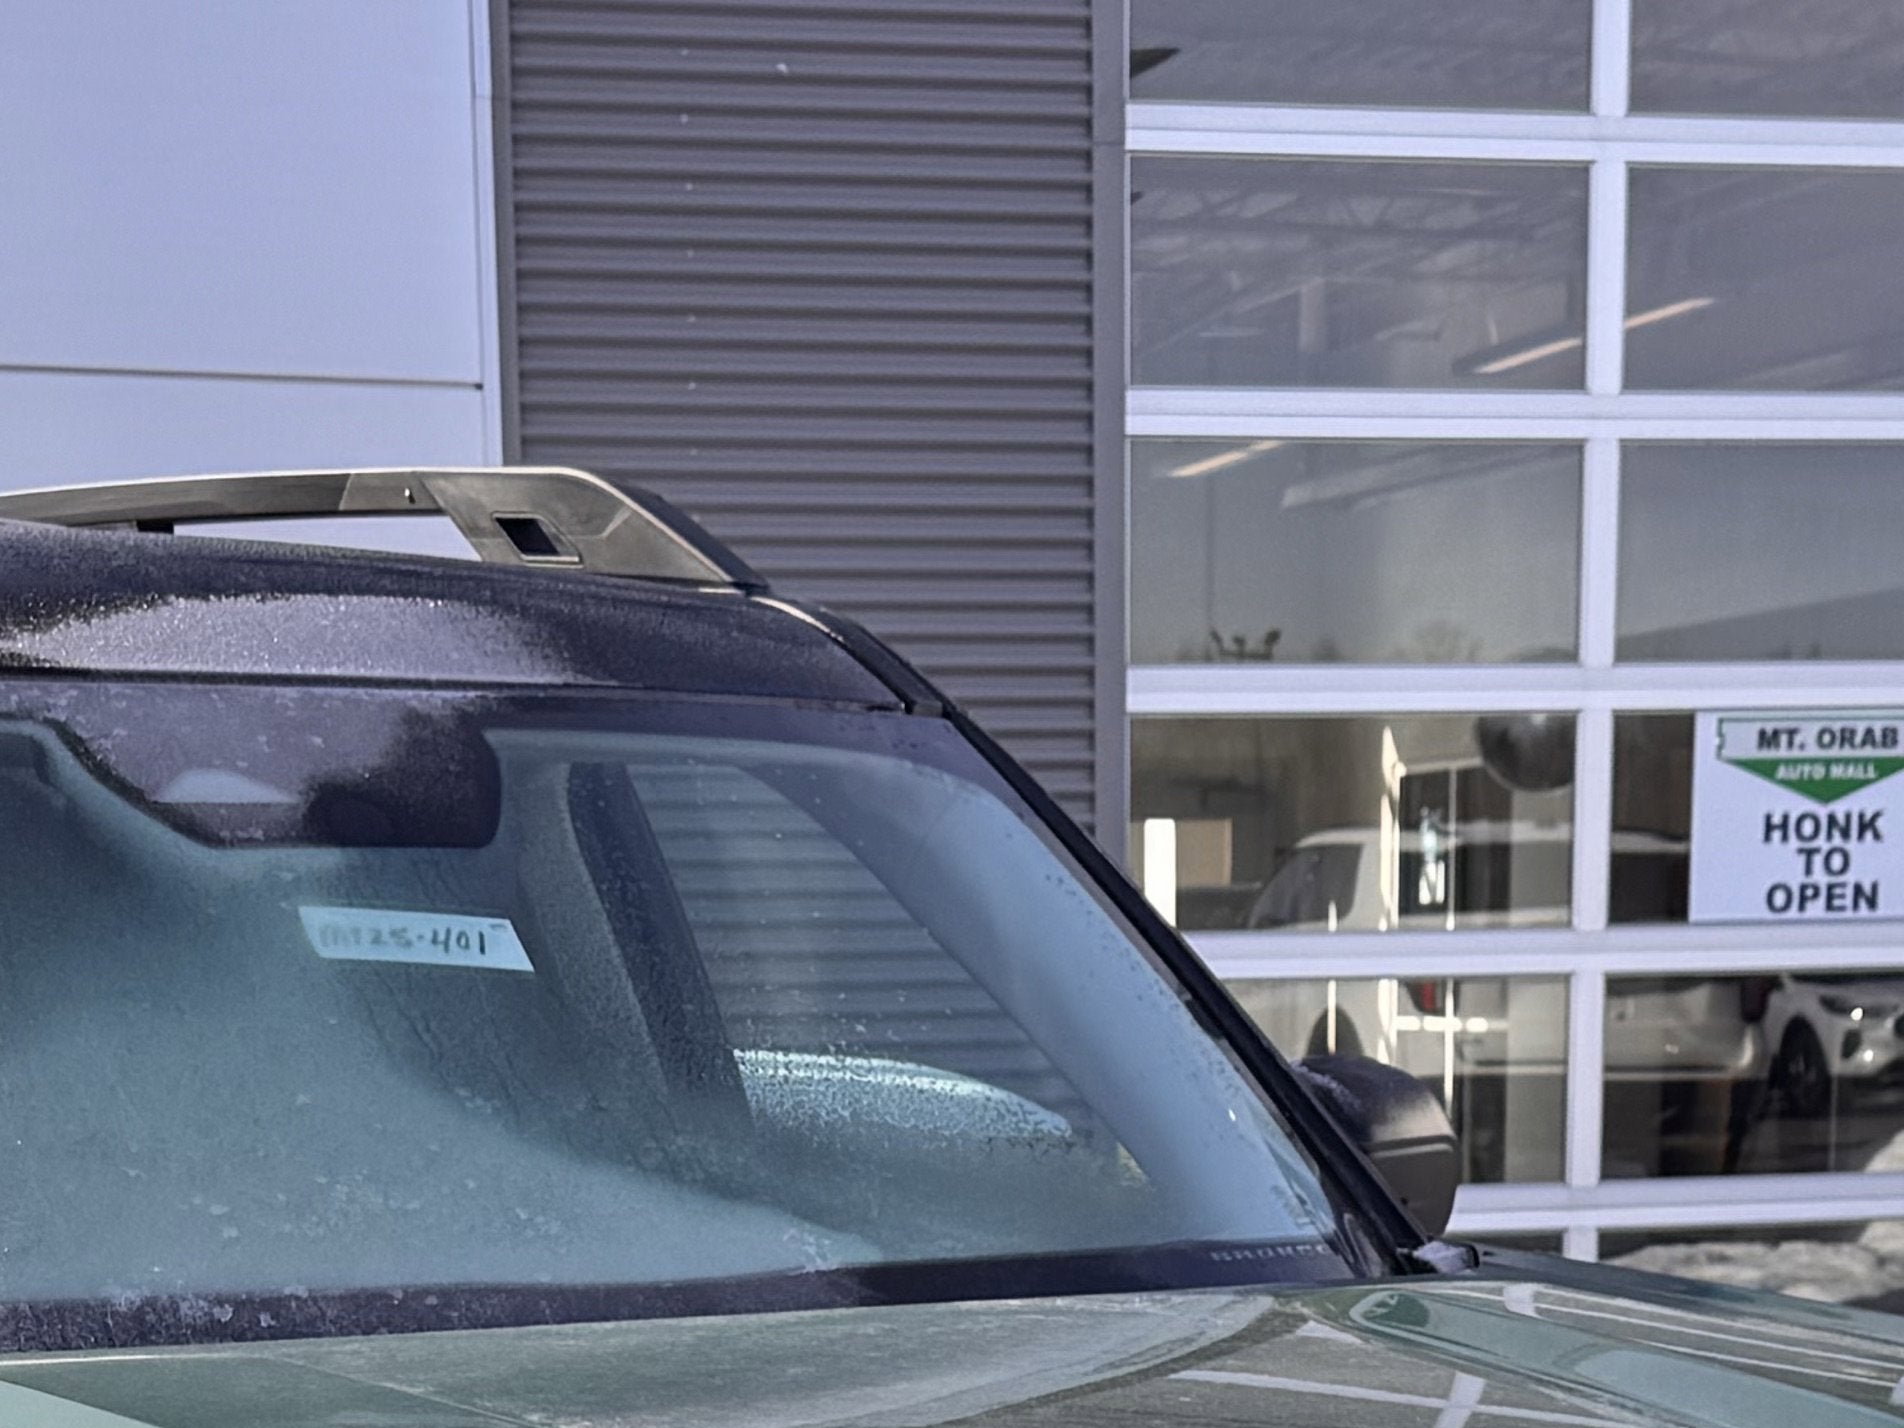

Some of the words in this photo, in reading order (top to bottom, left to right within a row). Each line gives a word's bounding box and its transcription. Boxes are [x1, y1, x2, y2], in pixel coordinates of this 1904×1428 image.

[1756, 727, 1806, 750] MT.
[1816, 726, 1899, 749] ORAB
[1775, 763, 1825, 780] AUTO
[1830, 762, 1878, 779] MALL
[1762, 810, 1885, 844] HONK
[1797, 847, 1850, 877] TO
[1766, 881, 1879, 913] OPEN
